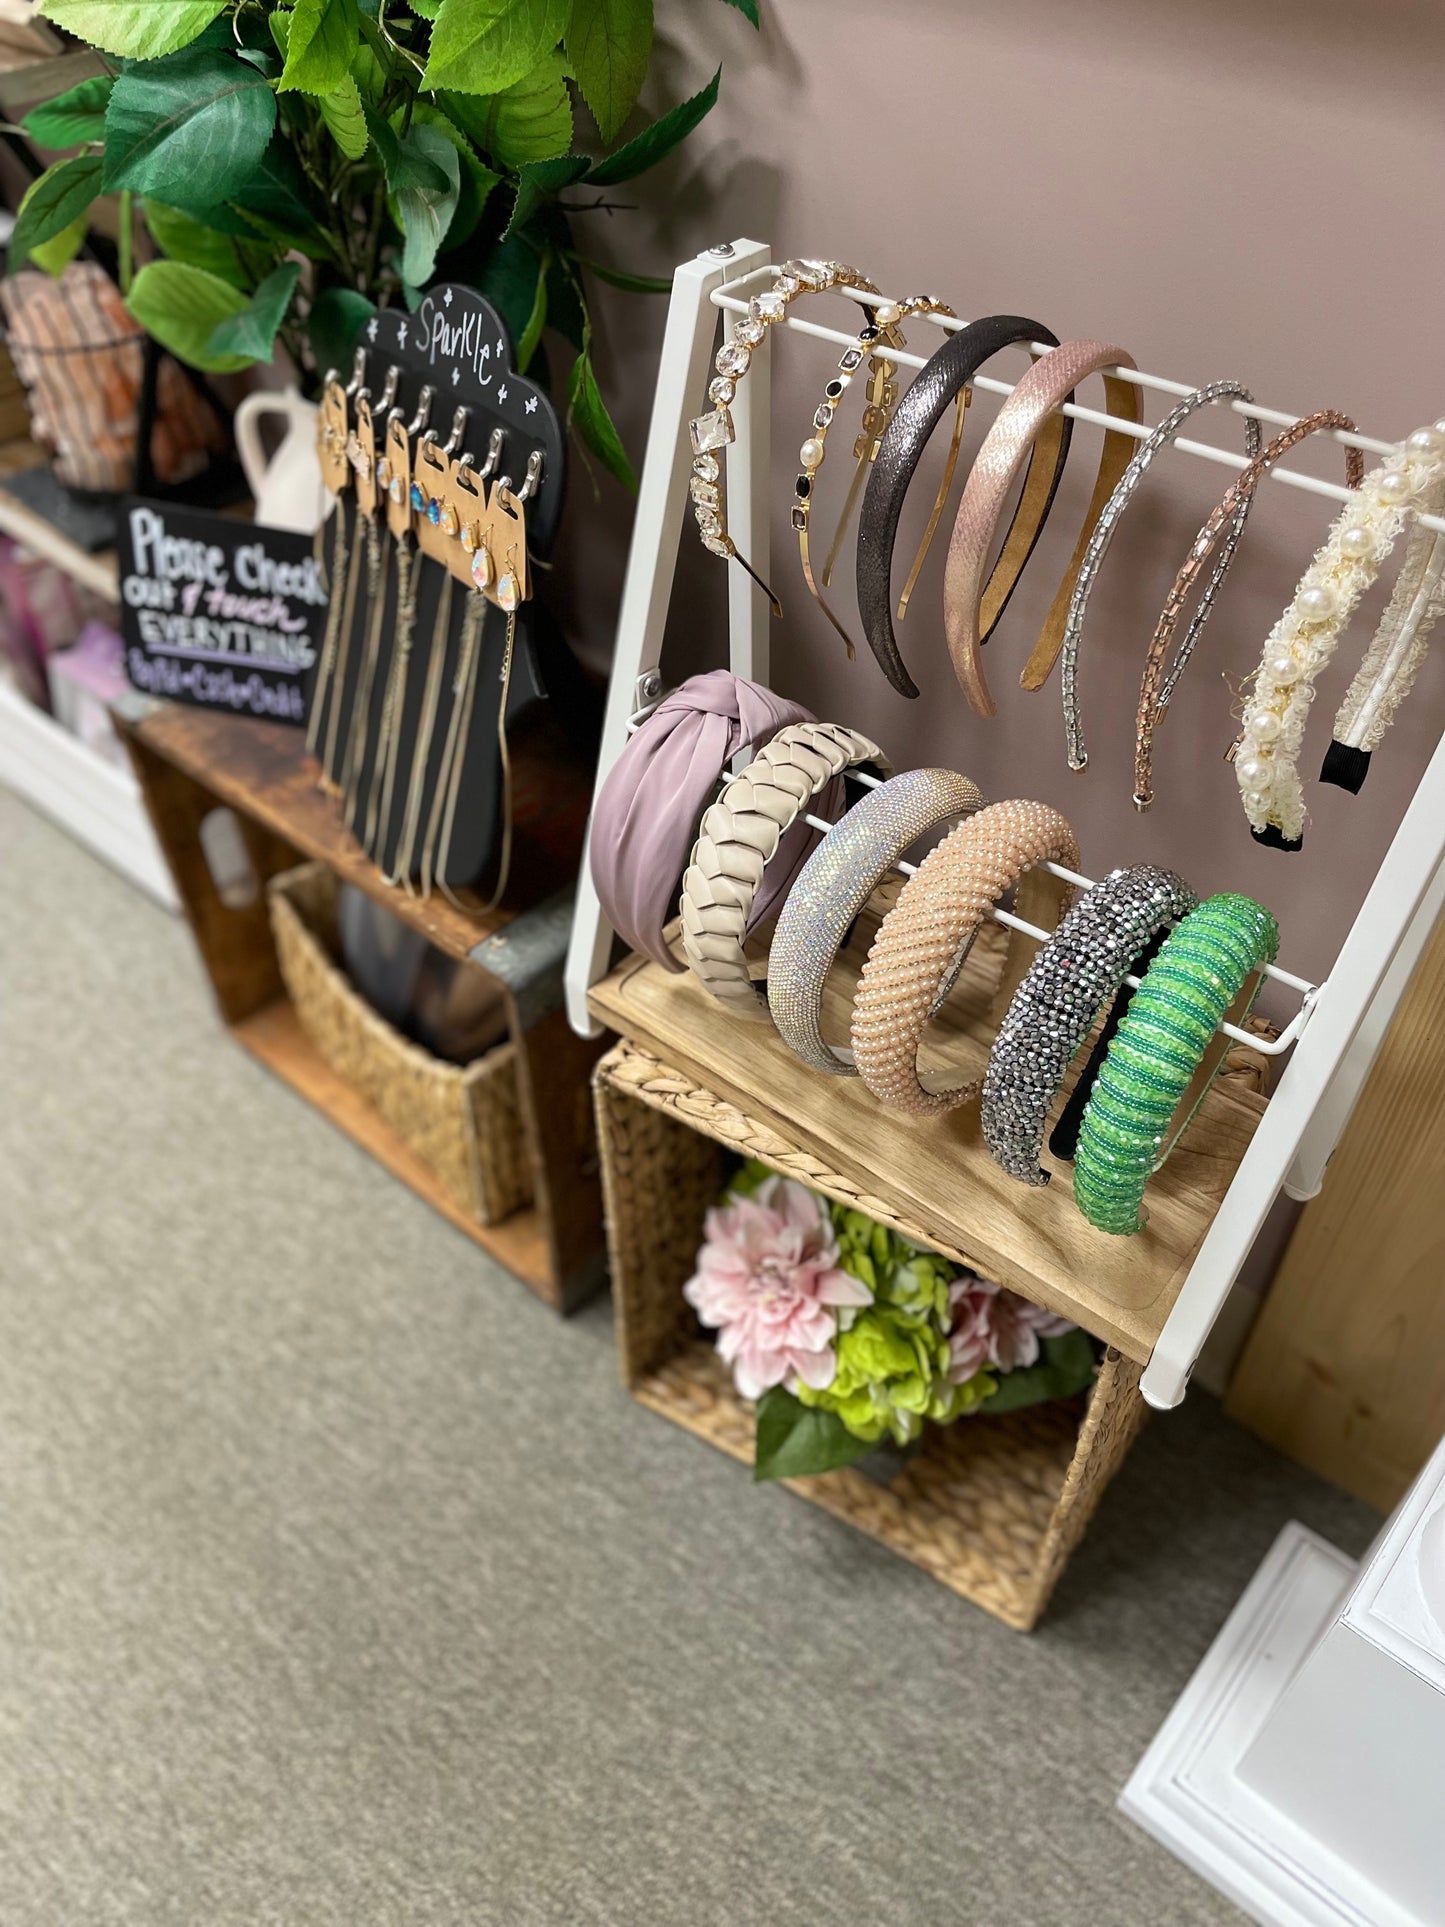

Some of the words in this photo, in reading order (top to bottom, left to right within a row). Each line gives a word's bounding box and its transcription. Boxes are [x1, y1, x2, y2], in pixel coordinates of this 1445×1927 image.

[130, 507, 229, 587] Please
[123, 575, 177, 611] out
[204, 588, 307, 632] touch
[137, 609, 317, 670] EVERYTHING
